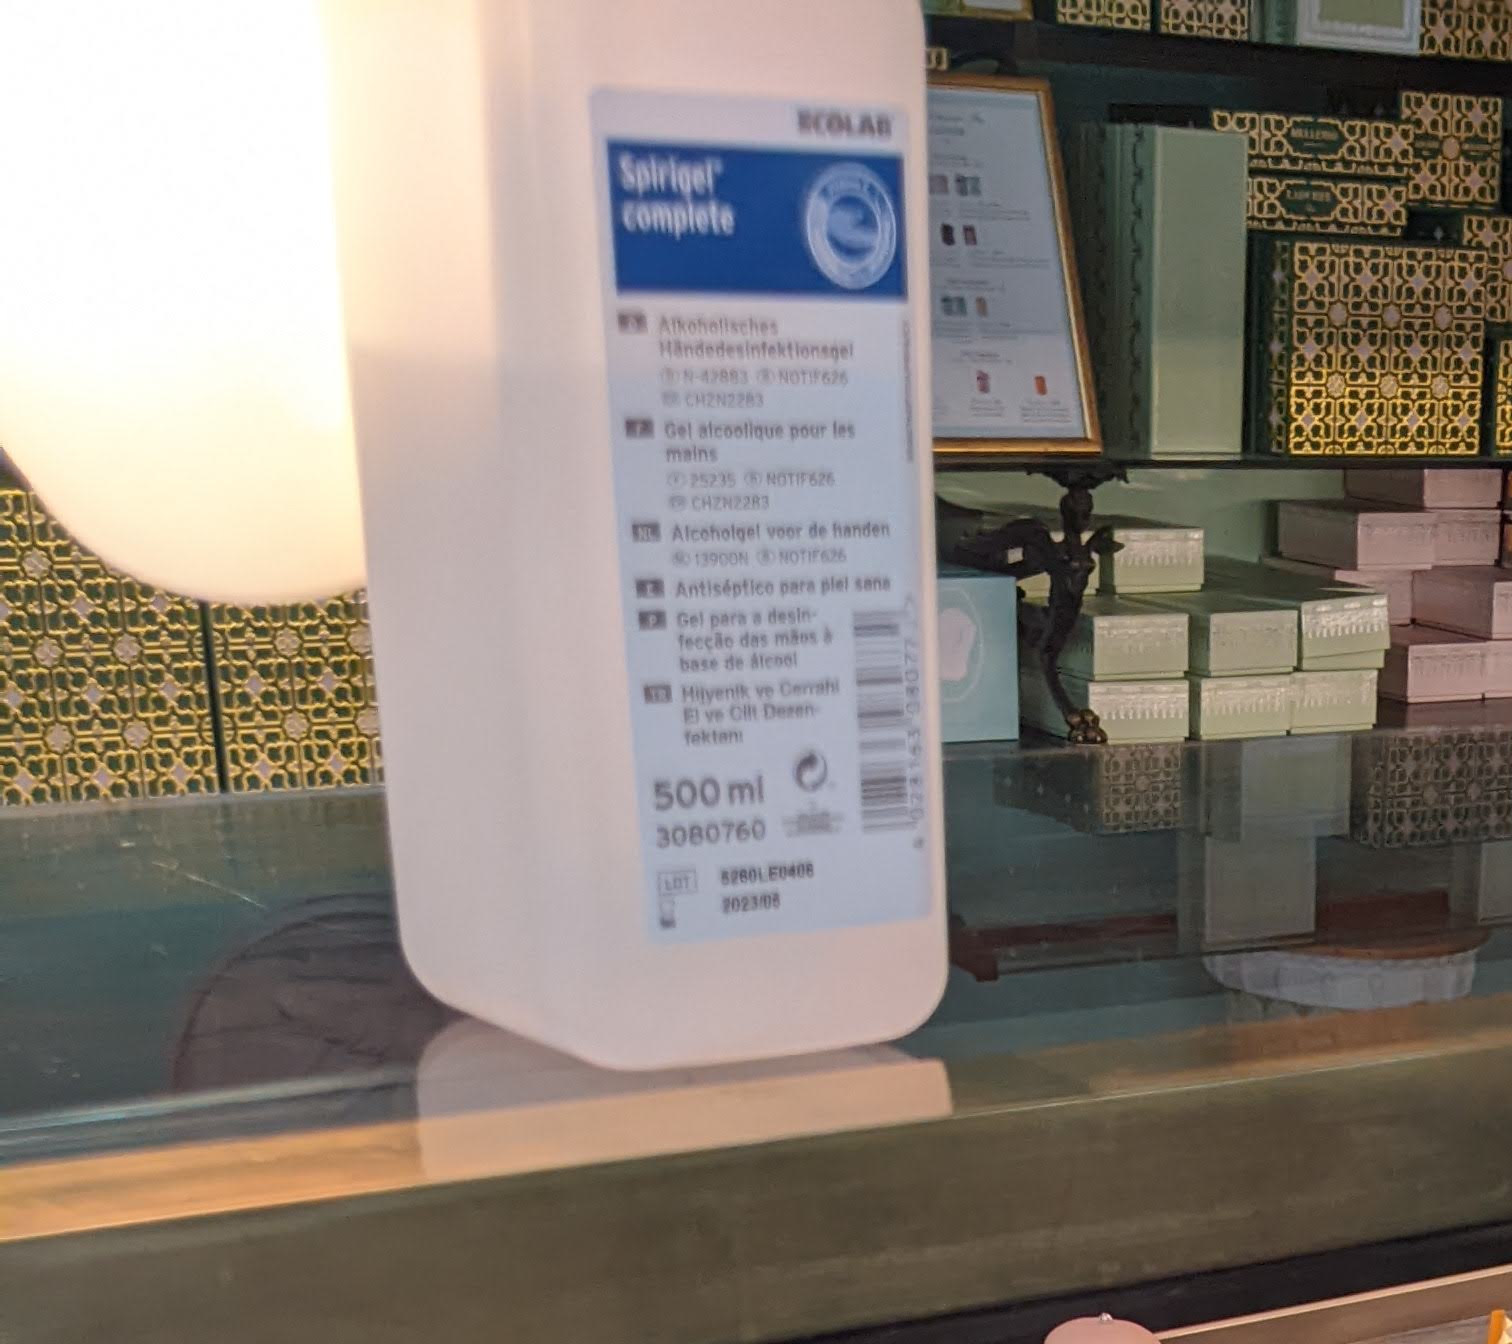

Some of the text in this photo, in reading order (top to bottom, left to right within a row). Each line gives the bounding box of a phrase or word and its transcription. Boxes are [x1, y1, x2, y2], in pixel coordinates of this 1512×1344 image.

[798, 111, 891, 136] ECOLAB
[622, 200, 734, 239] complete
[659, 315, 778, 336] Alkoholisches
[659, 340, 853, 363] Händedesinfektionsgel
[664, 420, 855, 440] Gel alcoolique pour les
[666, 446, 717, 462] mains
[691, 469, 835, 488] 25235 NOTIF626
[672, 521, 889, 543] Alcoholgel voor de handen
[675, 576, 890, 598] Antiséptico para piel sana
[676, 607, 816, 631] Gel para a desin-
[678, 627, 832, 651] fecção das mãos à
[679, 652, 797, 672] base de álcool
[755, 685, 774, 700] ve
[683, 707, 699, 724] El
[705, 709, 724, 723] ve
[729, 704, 757, 720] Cilt
[654, 775, 764, 811] 500 ml
[657, 819, 765, 848] 3080760
[665, 876, 689, 891] LOT
